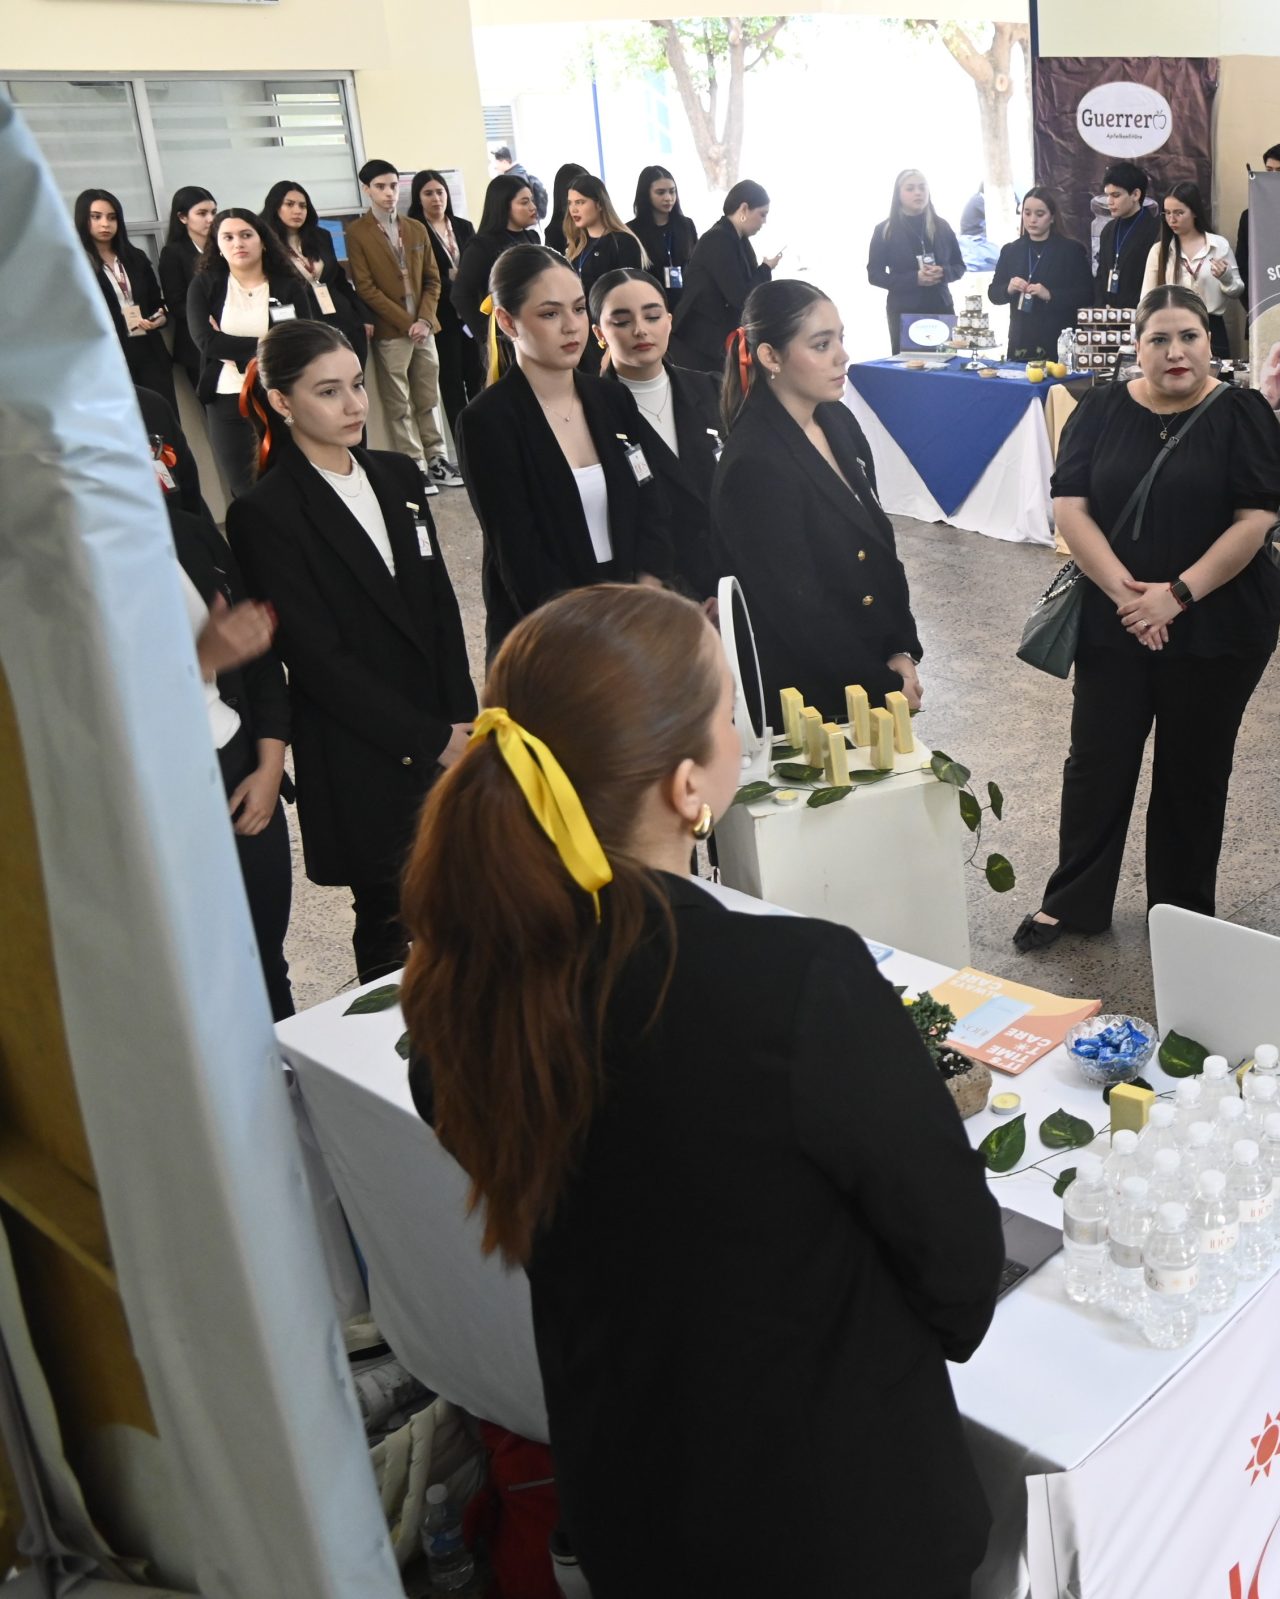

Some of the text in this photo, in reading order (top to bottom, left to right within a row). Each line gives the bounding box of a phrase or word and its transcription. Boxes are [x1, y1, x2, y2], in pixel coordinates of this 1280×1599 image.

[1004, 1027, 1052, 1047] CARE
[985, 1045, 1029, 1063] TIME
[989, 1057, 1023, 1071] IT'S
